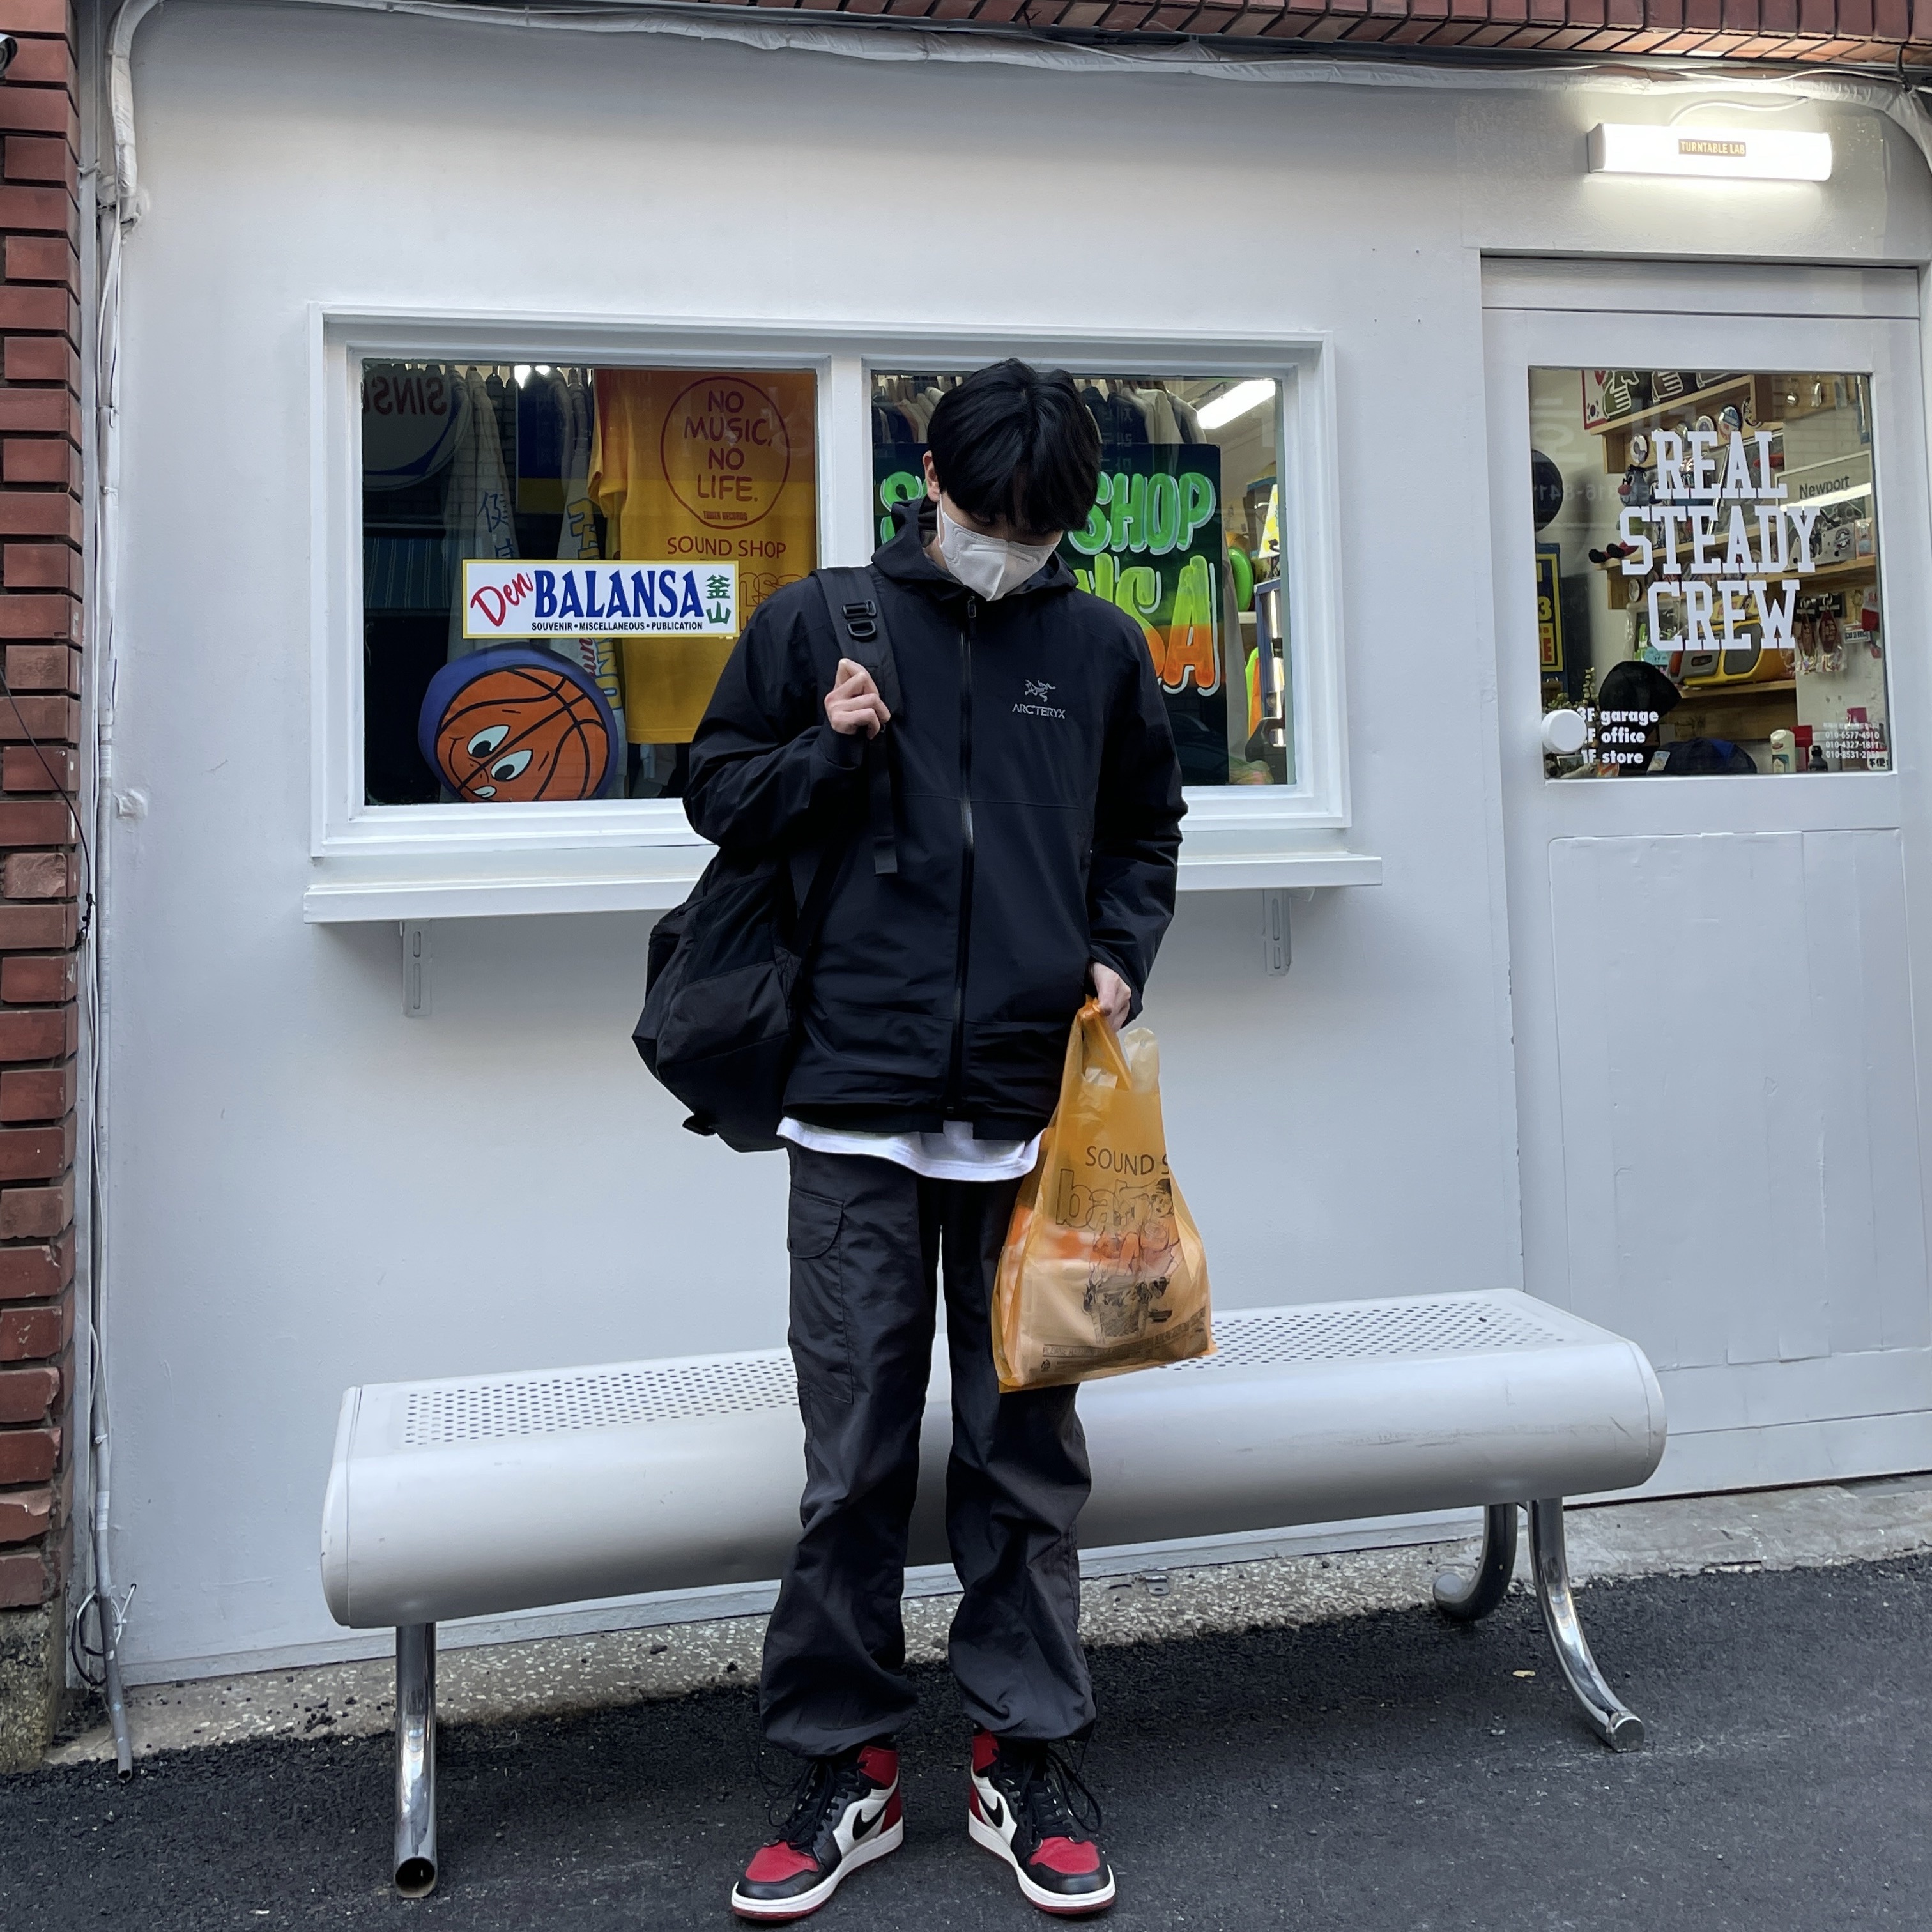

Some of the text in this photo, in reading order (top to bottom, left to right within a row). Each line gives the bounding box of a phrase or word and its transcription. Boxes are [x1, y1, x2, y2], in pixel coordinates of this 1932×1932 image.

[1681, 141, 1745, 155] TURNTABLE LAB
[708, 390, 744, 413] NO
[708, 448, 745, 470] NO
[1652, 431, 1788, 498] REAL
[697, 474, 758, 502] LIFE.
[1800, 475, 1850, 499] Newport
[667, 536, 786, 558] SOUND SHOP
[1619, 505, 1820, 575] STEADY
[470, 569, 704, 627] Den BALANSA
[532, 622, 703, 631] SOUVENIR MISCELLANEOUS PUBLICATION
[1647, 579, 1800, 651] CREW
[1600, 710, 1659, 726] garage
[1584, 726, 1646, 744] F office
[1581, 749, 1644, 764] 1F store
[1085, 1146, 1154, 1176] SOUND
